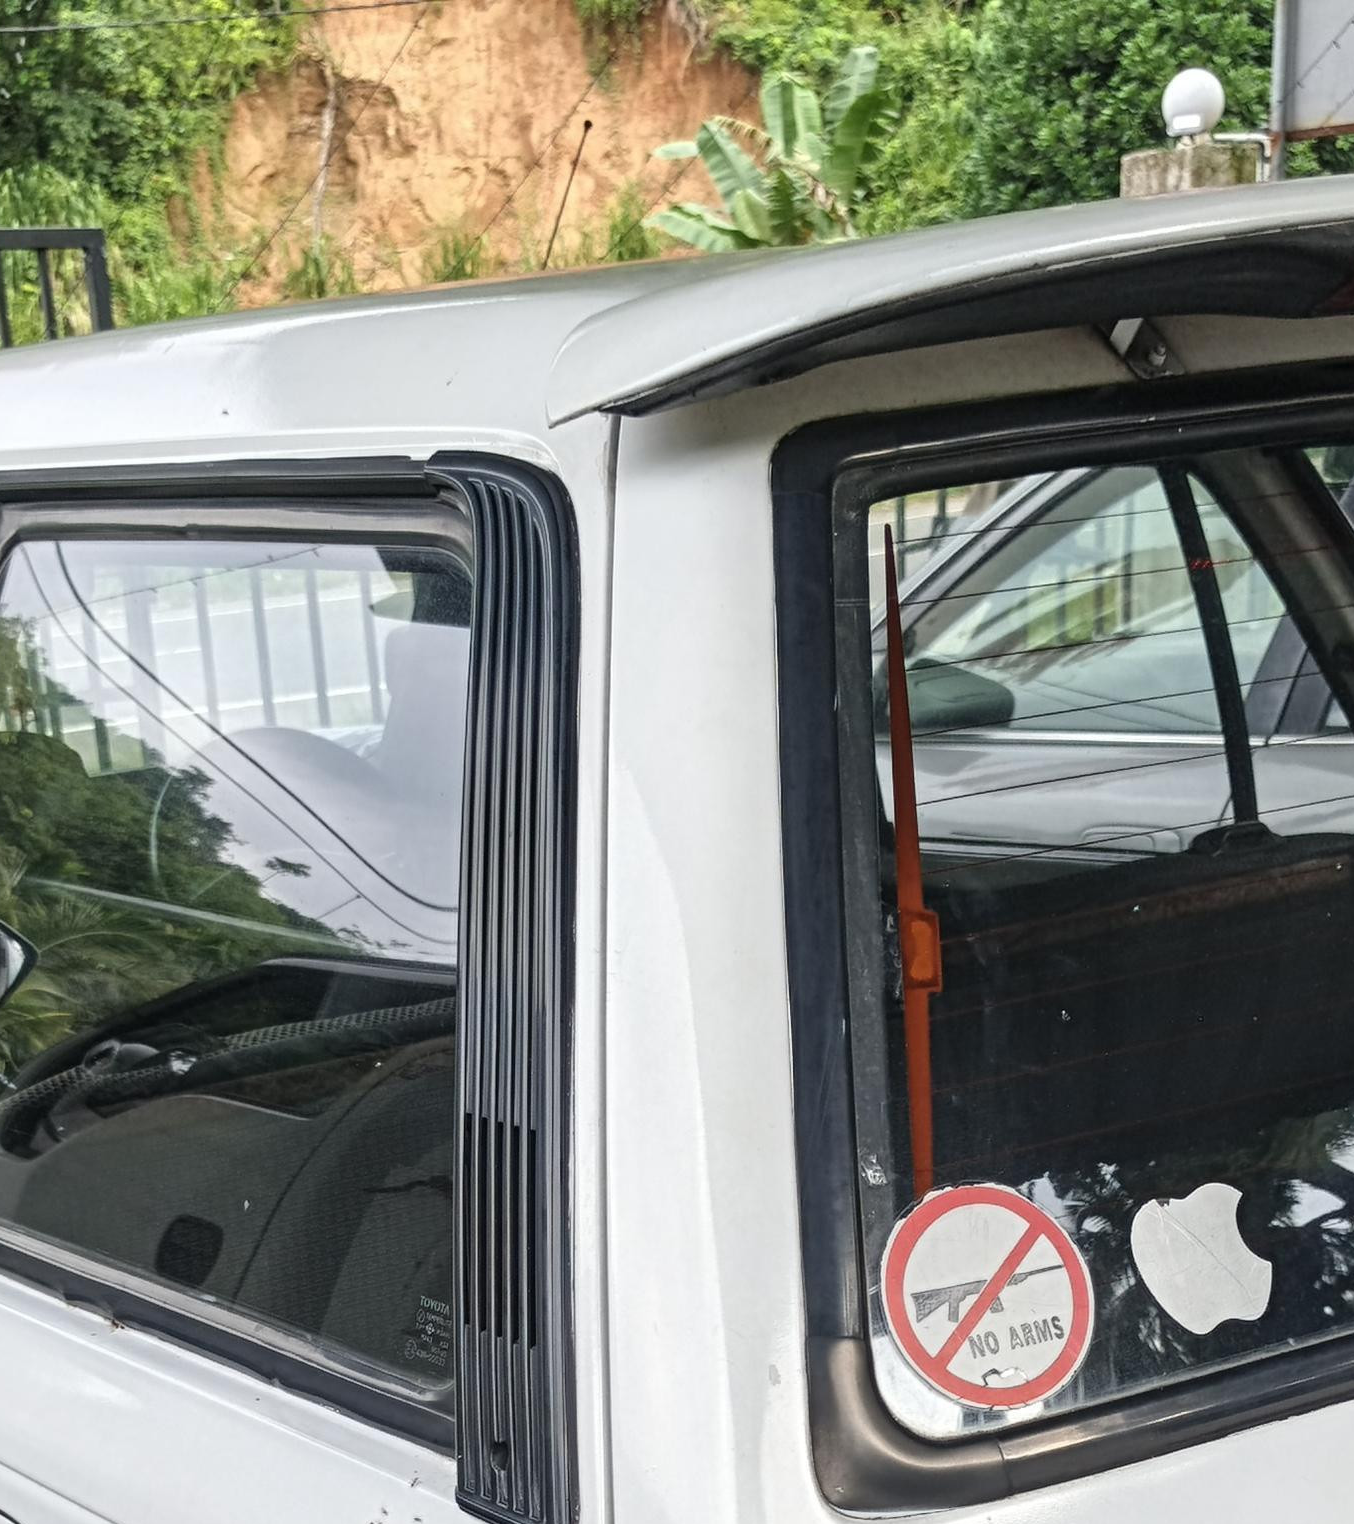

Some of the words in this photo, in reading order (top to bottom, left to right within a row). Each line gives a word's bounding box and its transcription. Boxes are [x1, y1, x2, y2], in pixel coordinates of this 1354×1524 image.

[420, 1295, 450, 1317] TOYOTA
[969, 1331, 1000, 1358] NO
[1010, 1316, 1065, 1350] ARMS
